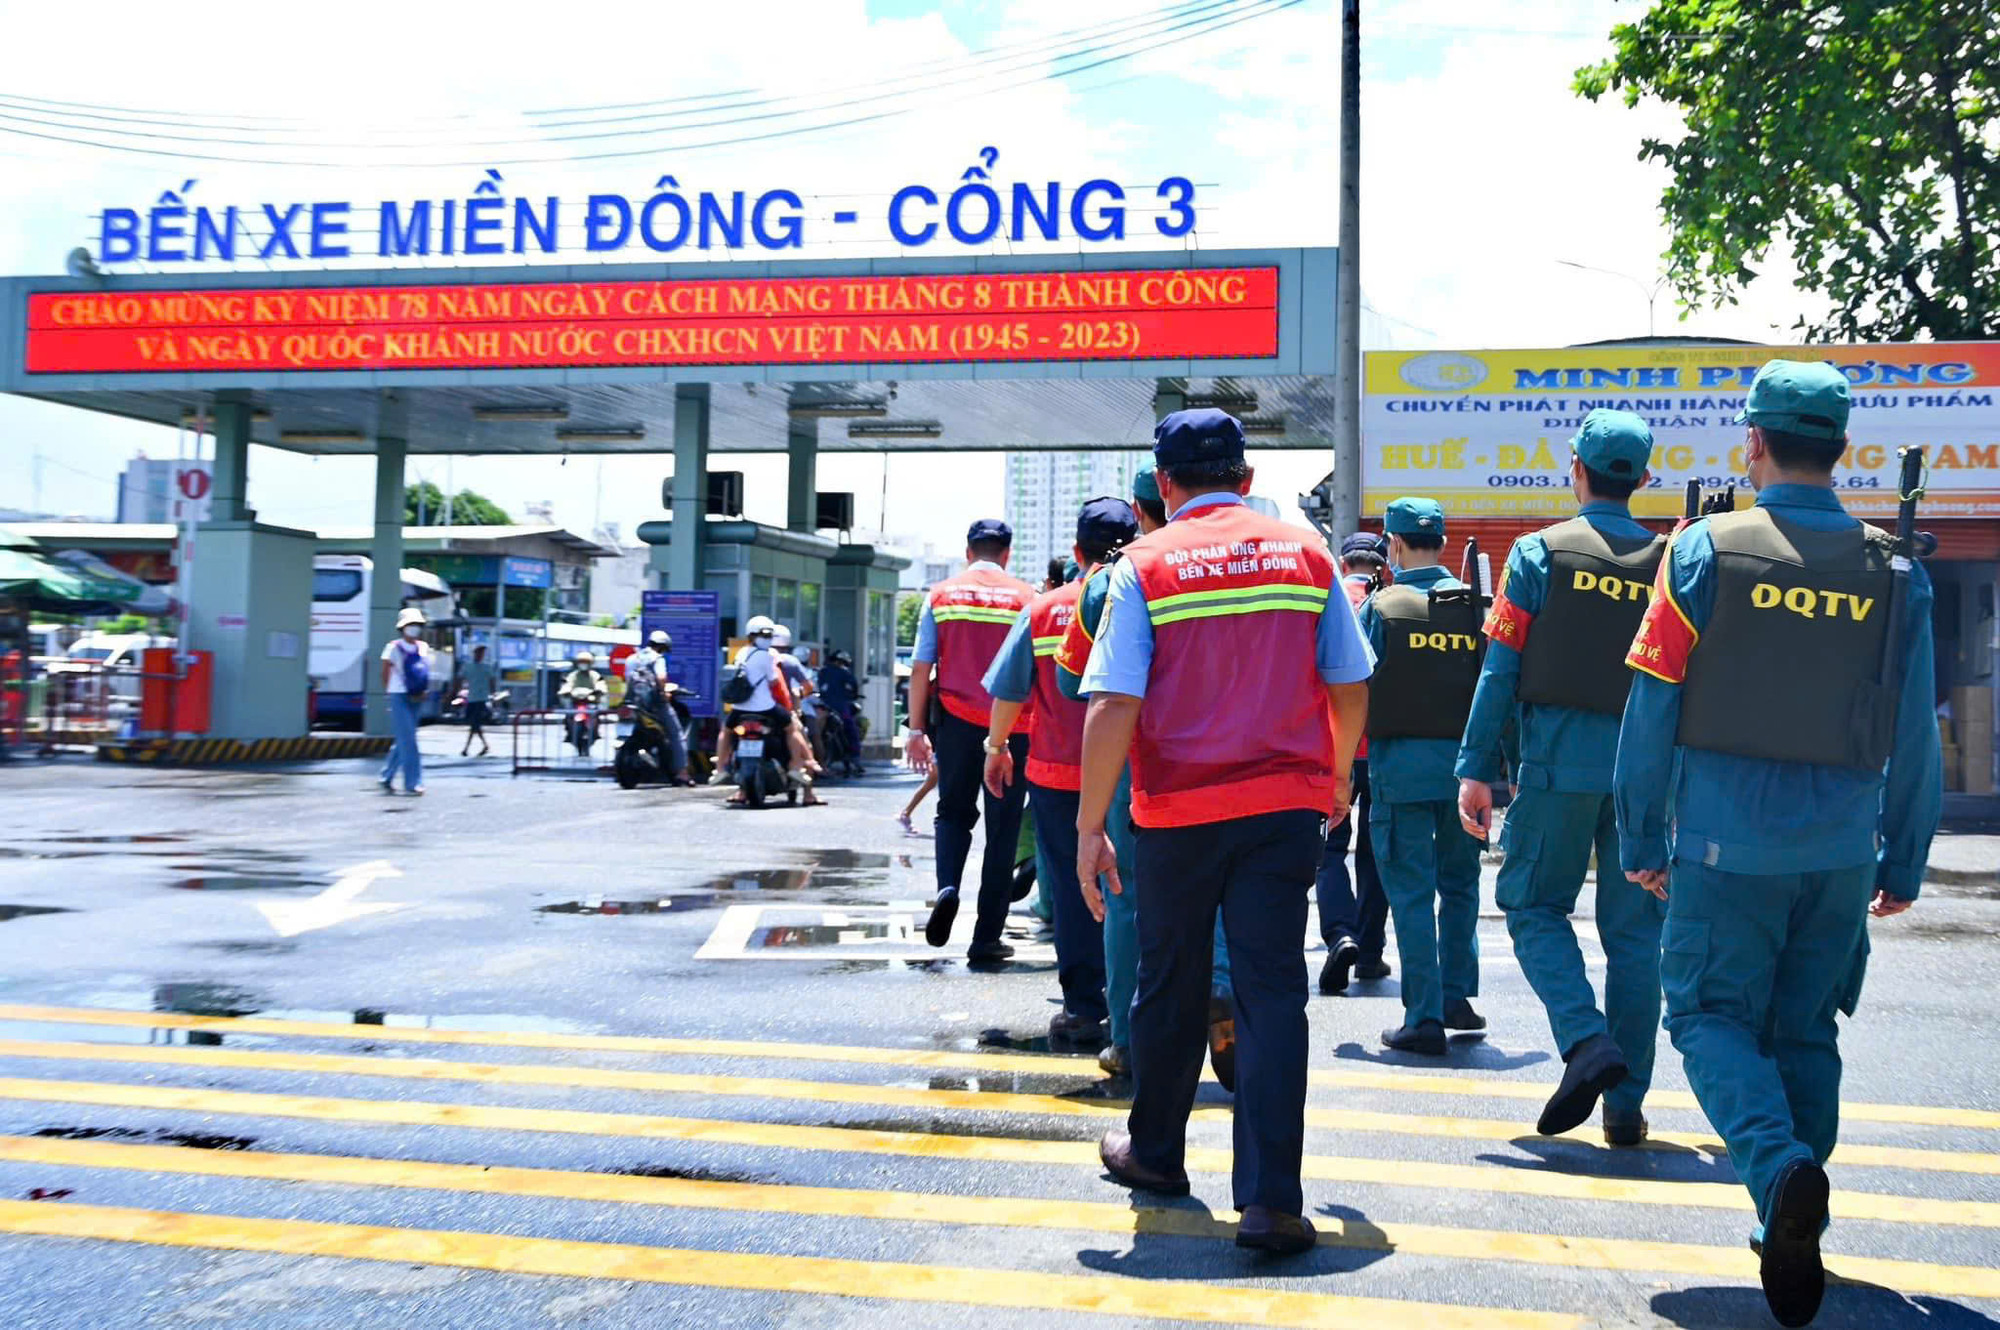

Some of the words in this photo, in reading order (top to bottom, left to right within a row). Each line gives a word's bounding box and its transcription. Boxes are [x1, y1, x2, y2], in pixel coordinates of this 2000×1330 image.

[101, 179, 238, 263] BẾN
[259, 202, 351, 260] XE
[379, 168, 560, 258] MIỀN
[584, 174, 804, 253] ĐÔNG
[833, 210, 857, 224] -
[888, 146, 1126, 247] CỔNG
[1155, 176, 1197, 237] 3
[51, 293, 142, 325] CHÀO
[306, 291, 390, 325] NIỆM
[398, 293, 429, 320] 78
[519, 283, 614, 317] NGÀY
[622, 282, 718, 315] CÁCH
[729, 284, 832, 317] MẠNG
[841, 277, 965, 311] THÁNG
[974, 281, 992, 309] 8
[1000, 275, 1129, 308] THÀNH
[1139, 270, 1246, 305] CÔNG
[136, 331, 180, 361] VÀ
[186, 330, 274, 361] NGÀY
[383, 326, 500, 360] KHÁNH
[509, 323, 605, 358] NƯỚC
[614, 327, 761, 356] CHXHCN
[768, 324, 850, 359] VIỆT
[859, 325, 940, 353] NAM
[950, 323, 1029, 357] (1945
[1038, 336, 1049, 344] -
[1059, 321, 1141, 353] 2023)
[1512, 366, 1680, 390] MINH
[1697, 359, 1978, 388] PƠNG
[1578, 398, 1671, 412] NHANH
[1646, 414, 1707, 429] HẬN
[1165, 550, 1189, 566] ĐỘI
[1259, 541, 1303, 554] NHANH
[1178, 562, 1204, 580] BẾN
[1208, 562, 1225, 576] XE
[1262, 554, 1298, 571] ĐÔNG
[1751, 582, 1874, 622] DQTV
[1409, 632, 1477, 653] DQTV
